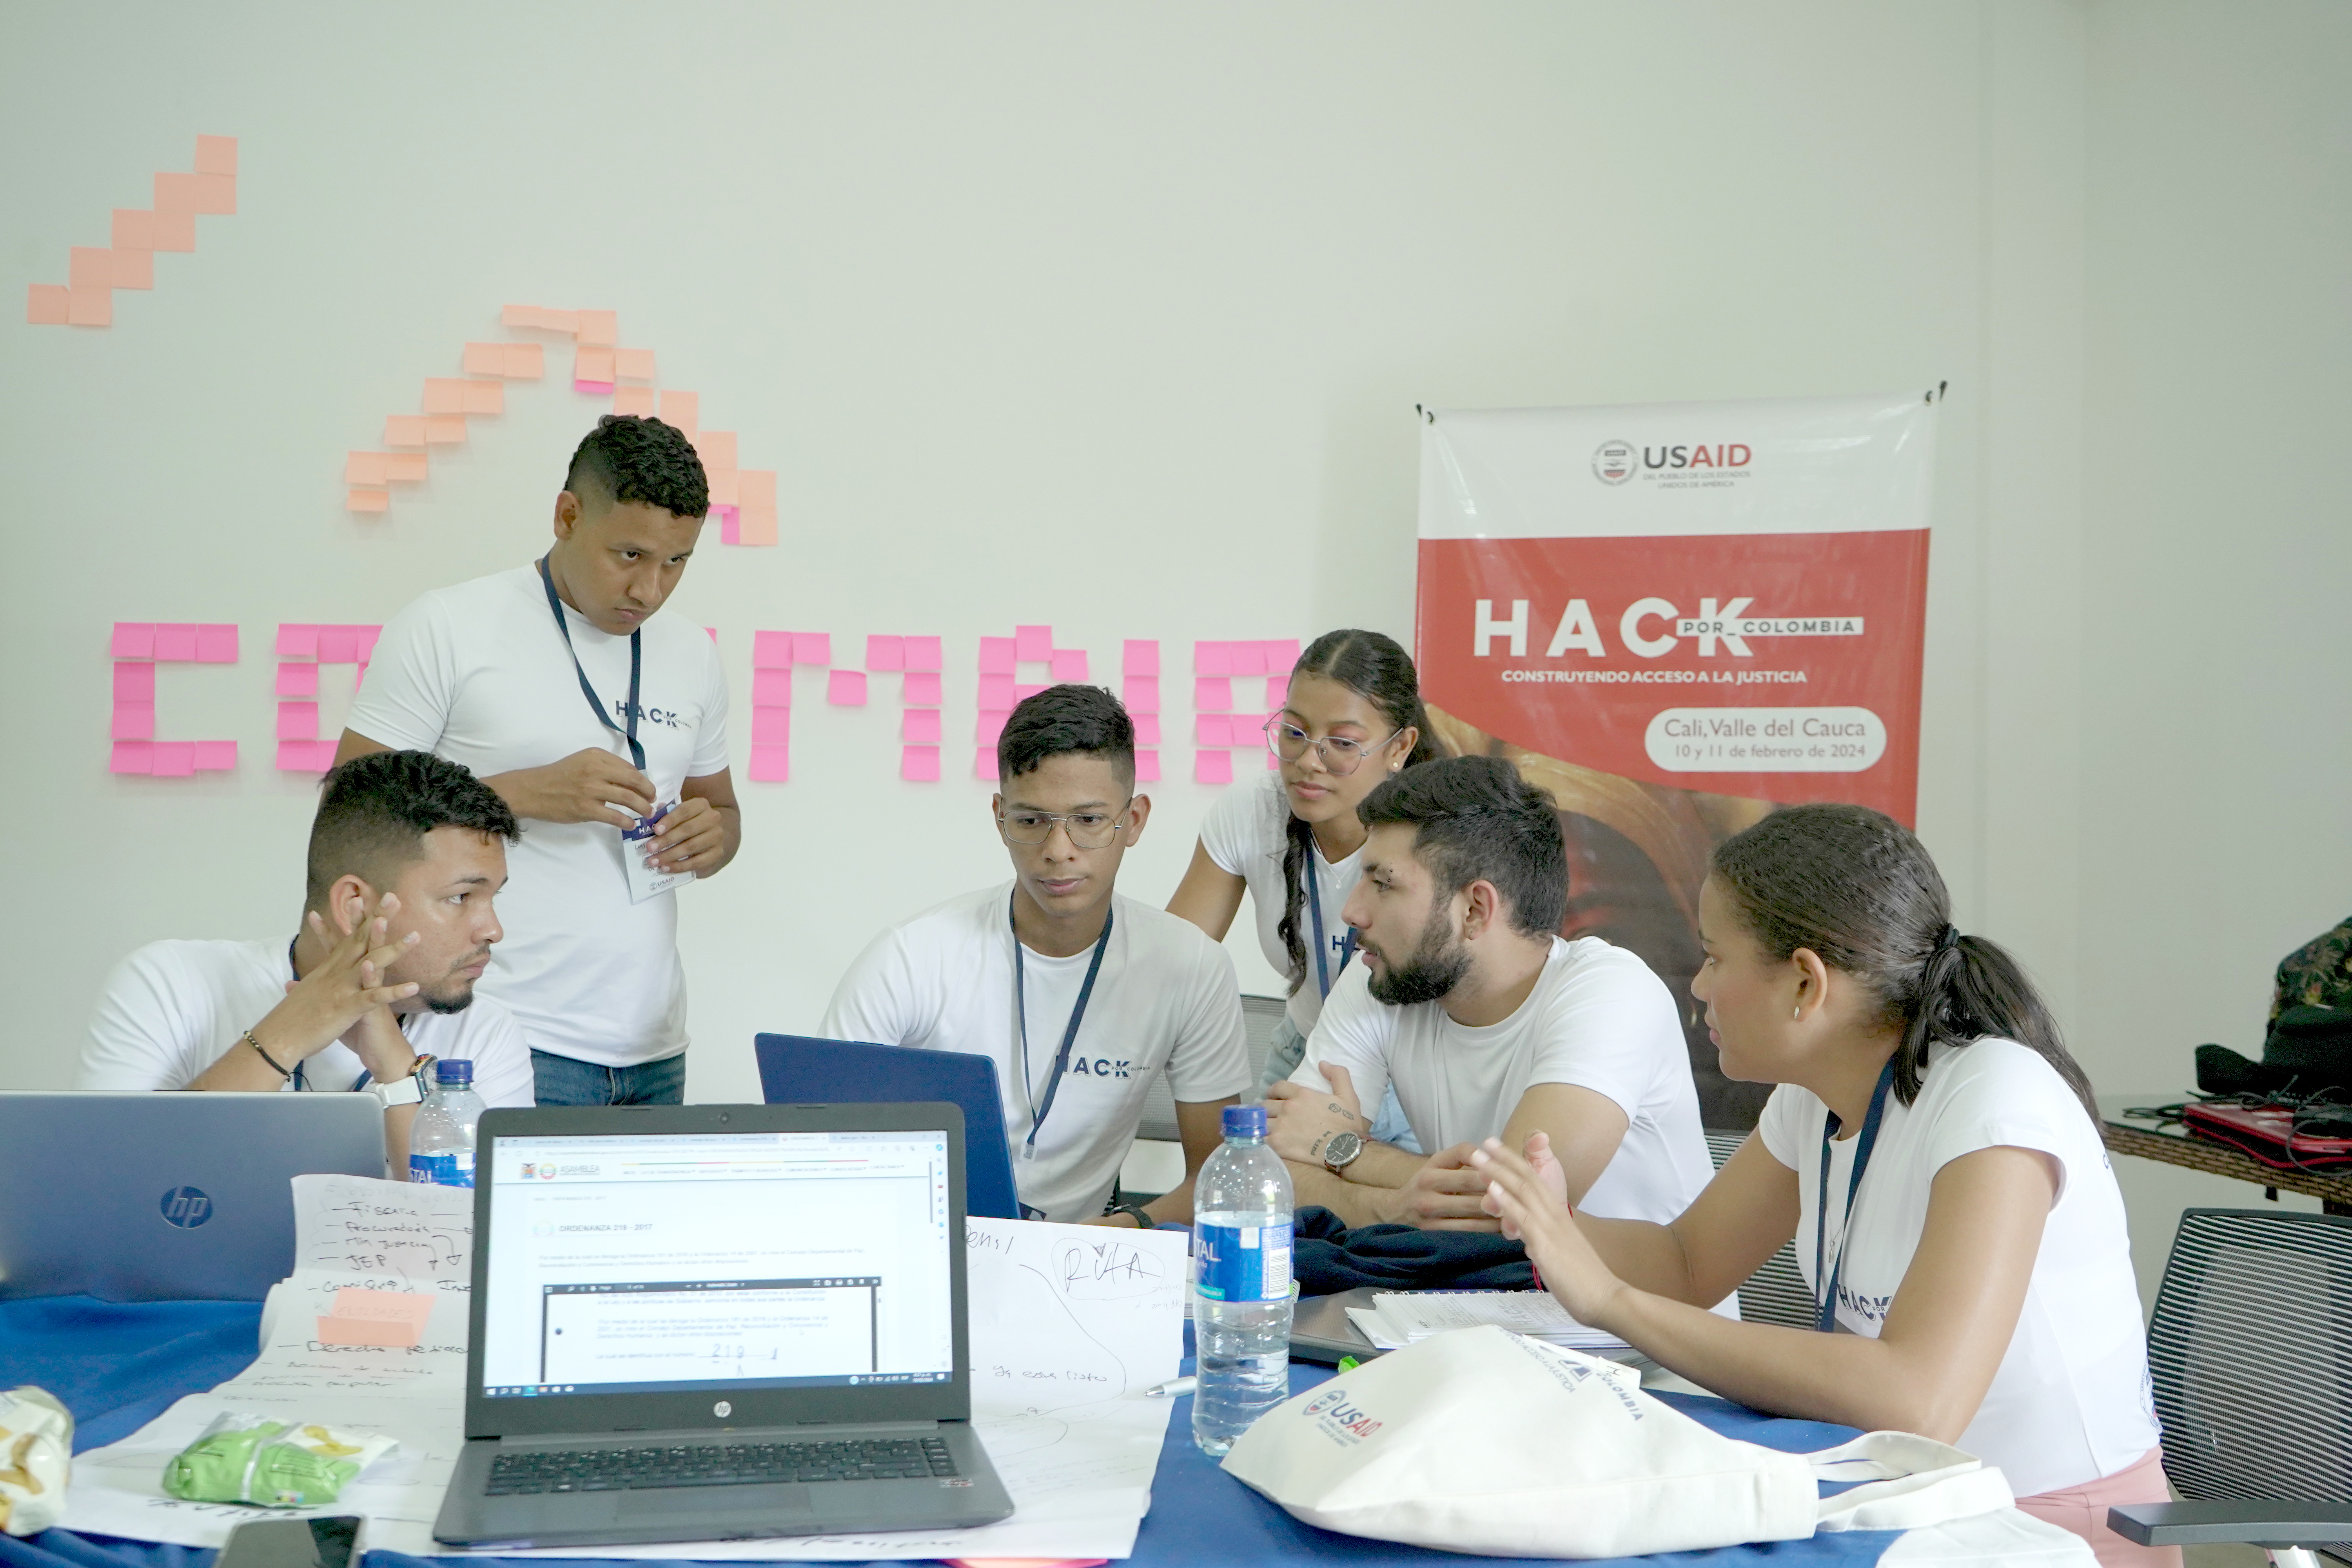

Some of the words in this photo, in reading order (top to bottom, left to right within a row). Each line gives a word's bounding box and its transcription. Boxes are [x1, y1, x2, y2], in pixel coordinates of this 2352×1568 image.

[1643, 444, 1752, 469] USAID
[1474, 597, 1755, 657] HACK
[1743, 620, 1856, 633] COLOMBIA
[1501, 670, 1630, 684] CONSTRUYENDO
[1632, 670, 1696, 684] ACCESO
[1697, 670, 1710, 683] A
[1713, 670, 1734, 683] LA
[1735, 669, 1808, 685] JUSTICIA
[675, 719, 692, 729] COLOMBIA
[1709, 718, 1756, 737] Valle
[1764, 718, 1794, 736] del
[1802, 717, 1866, 737] Cauca
[1675, 745, 1690, 757] 10
[1694, 748, 1703, 761] y
[1708, 745, 1722, 757] 11
[1729, 745, 1746, 757] de
[1751, 744, 1803, 758] febrero
[1808, 744, 1825, 757] de
[1830, 744, 1866, 757] 2024
[657, 876, 675, 886] USAID
[165, 1187, 208, 1229] hp
[1330, 1402, 1383, 1437] USAID
